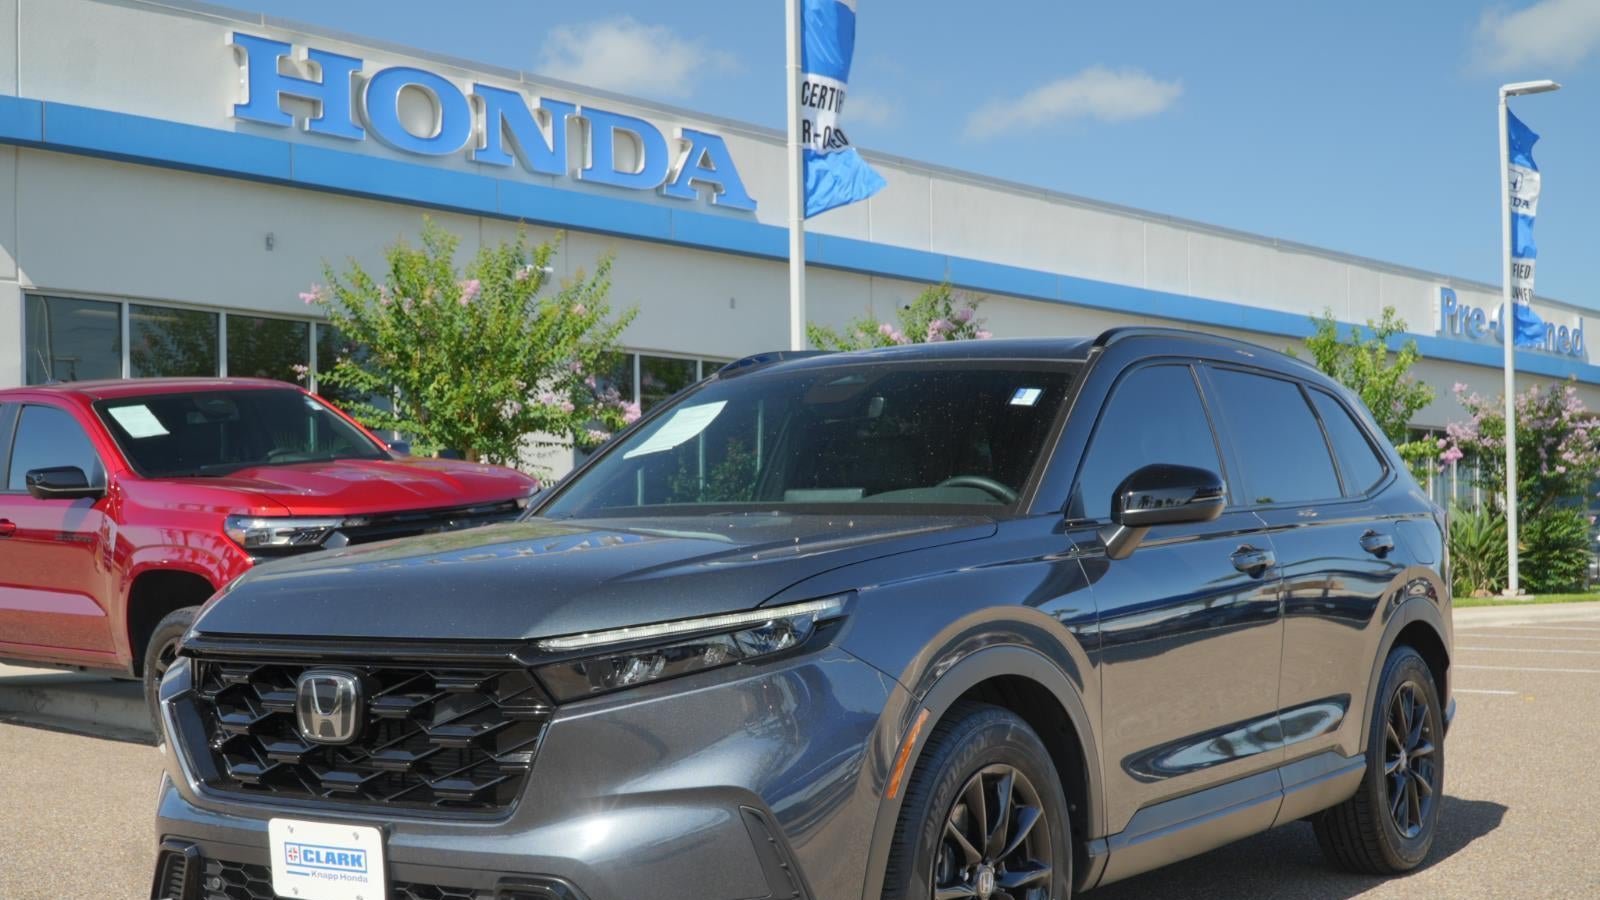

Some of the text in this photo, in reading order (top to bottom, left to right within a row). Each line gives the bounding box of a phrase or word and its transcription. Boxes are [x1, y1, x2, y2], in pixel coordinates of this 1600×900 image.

[228, 32, 757, 211] HONDA
[1510, 196, 1530, 210] DA
[1440, 286, 1584, 357] Pre-ned
[303, 849, 363, 868] CLARK
[311, 870, 368, 884] Knapp Honda
